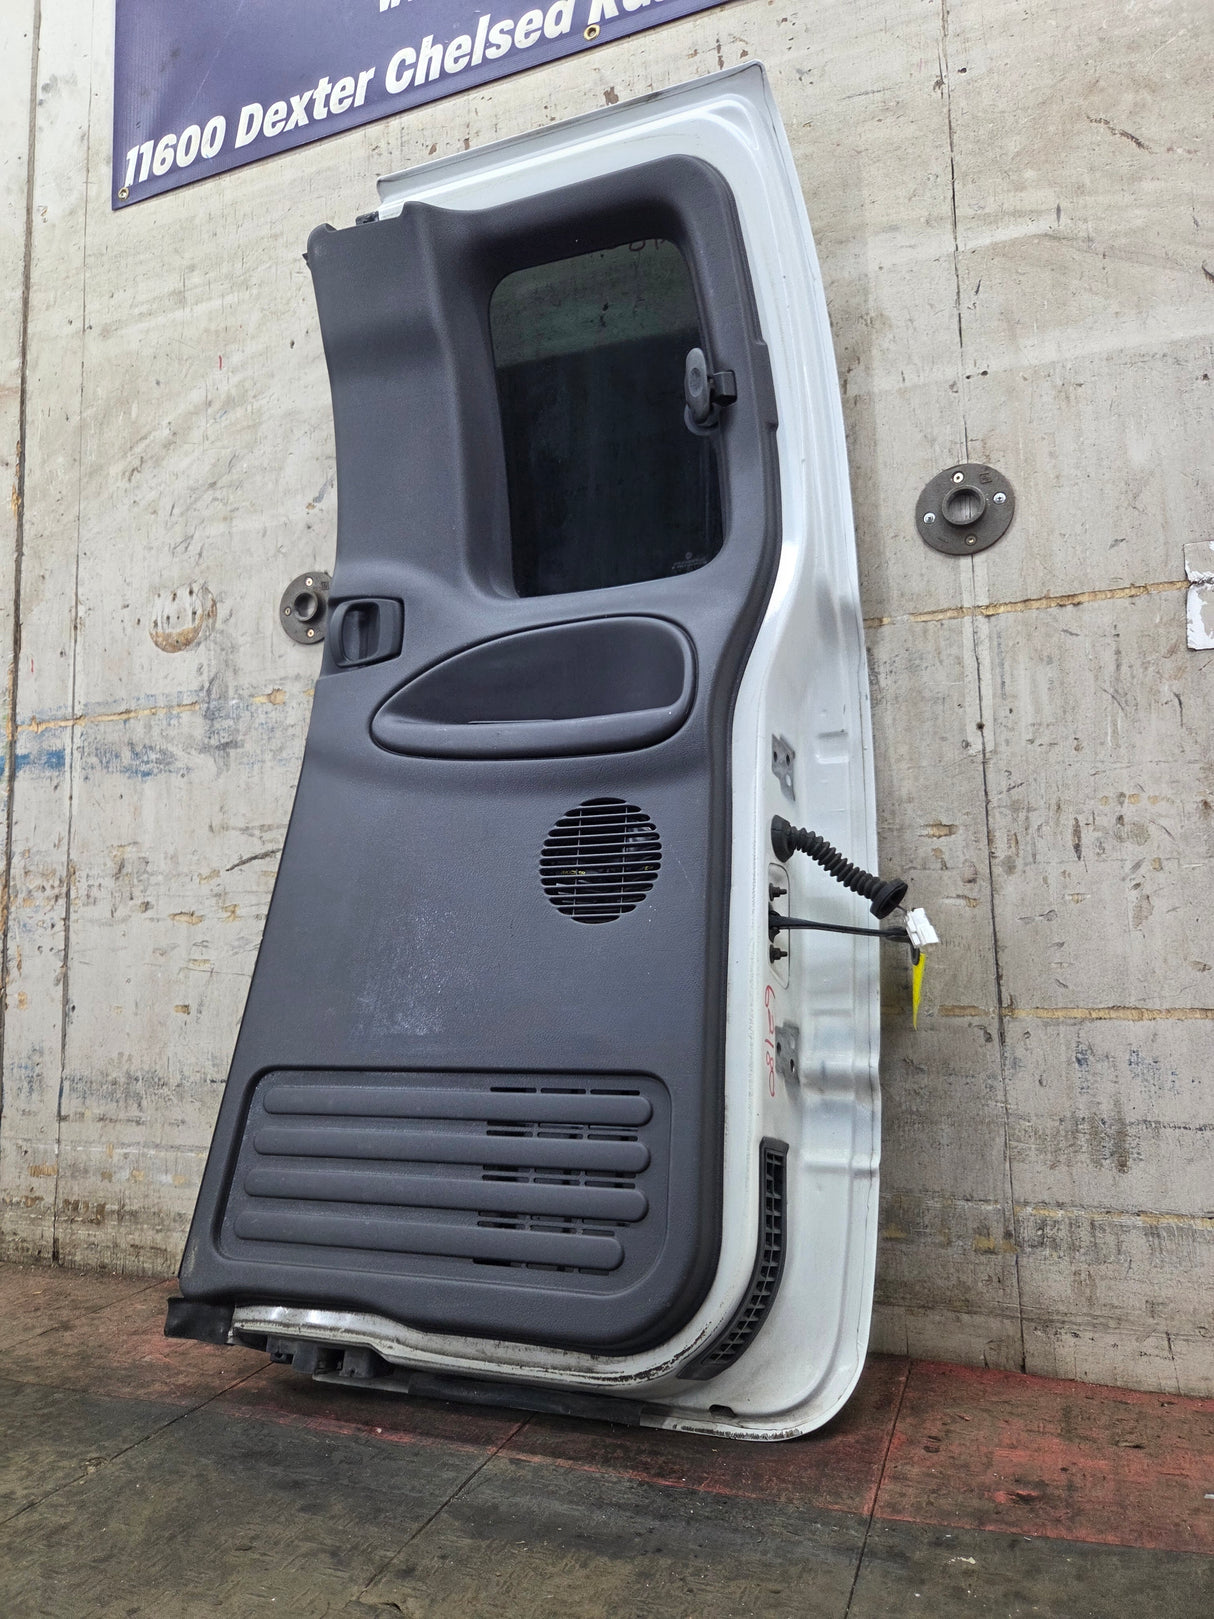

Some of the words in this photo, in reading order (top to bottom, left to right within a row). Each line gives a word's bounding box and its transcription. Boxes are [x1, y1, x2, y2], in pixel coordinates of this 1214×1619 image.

[123, 115, 227, 188] 11600
[234, 67, 377, 149] Dexter
[384, 0, 576, 94] Chelsea
